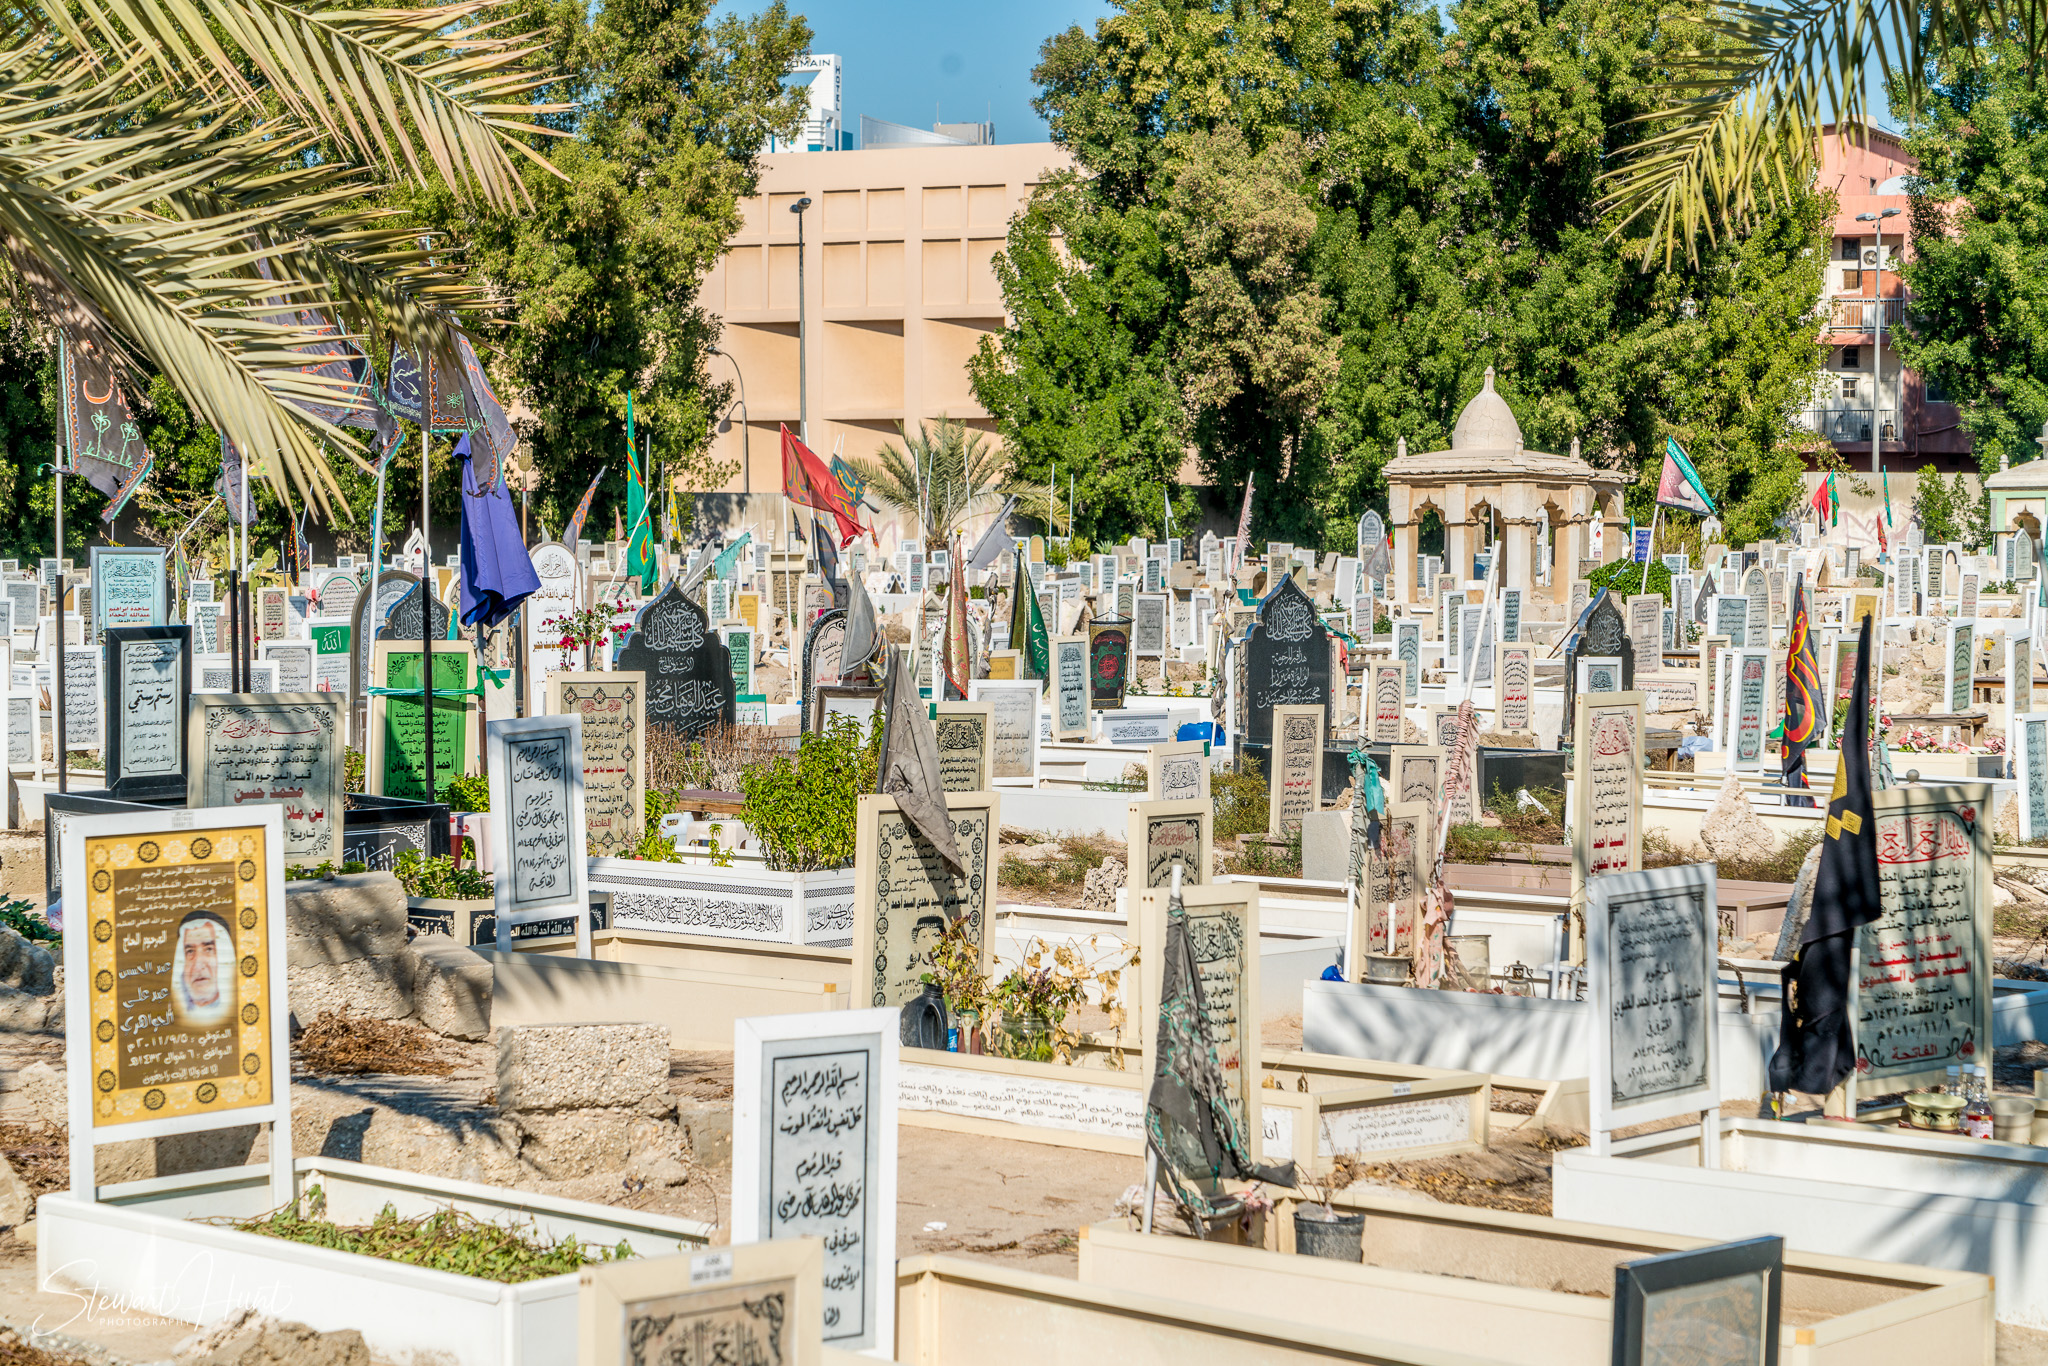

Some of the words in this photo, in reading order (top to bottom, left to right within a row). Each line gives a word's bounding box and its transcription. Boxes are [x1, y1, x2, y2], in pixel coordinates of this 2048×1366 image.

[322, 630, 341, 650] الله
[435, 755, 454, 770] أحمد
[255, 771, 292, 782] المرحوم
[293, 770, 312, 781] قبر
[233, 786, 265, 803] حسن
[270, 785, 305, 800] محمد
[308, 807, 324, 822] بن
[289, 829, 316, 842] تاريخ
[1593, 830, 1608, 848] أحمد
[1609, 832, 1626, 851] السيد
[1869, 954, 1916, 969] بهيجة
[1919, 945, 1962, 963] السيدة
[1909, 968, 1940, 984] محسن
[1942, 960, 1971, 979] السيد
[1902, 1000, 1939, 1016] القعدة
[1891, 1044, 1938, 1060] الفاتحة
